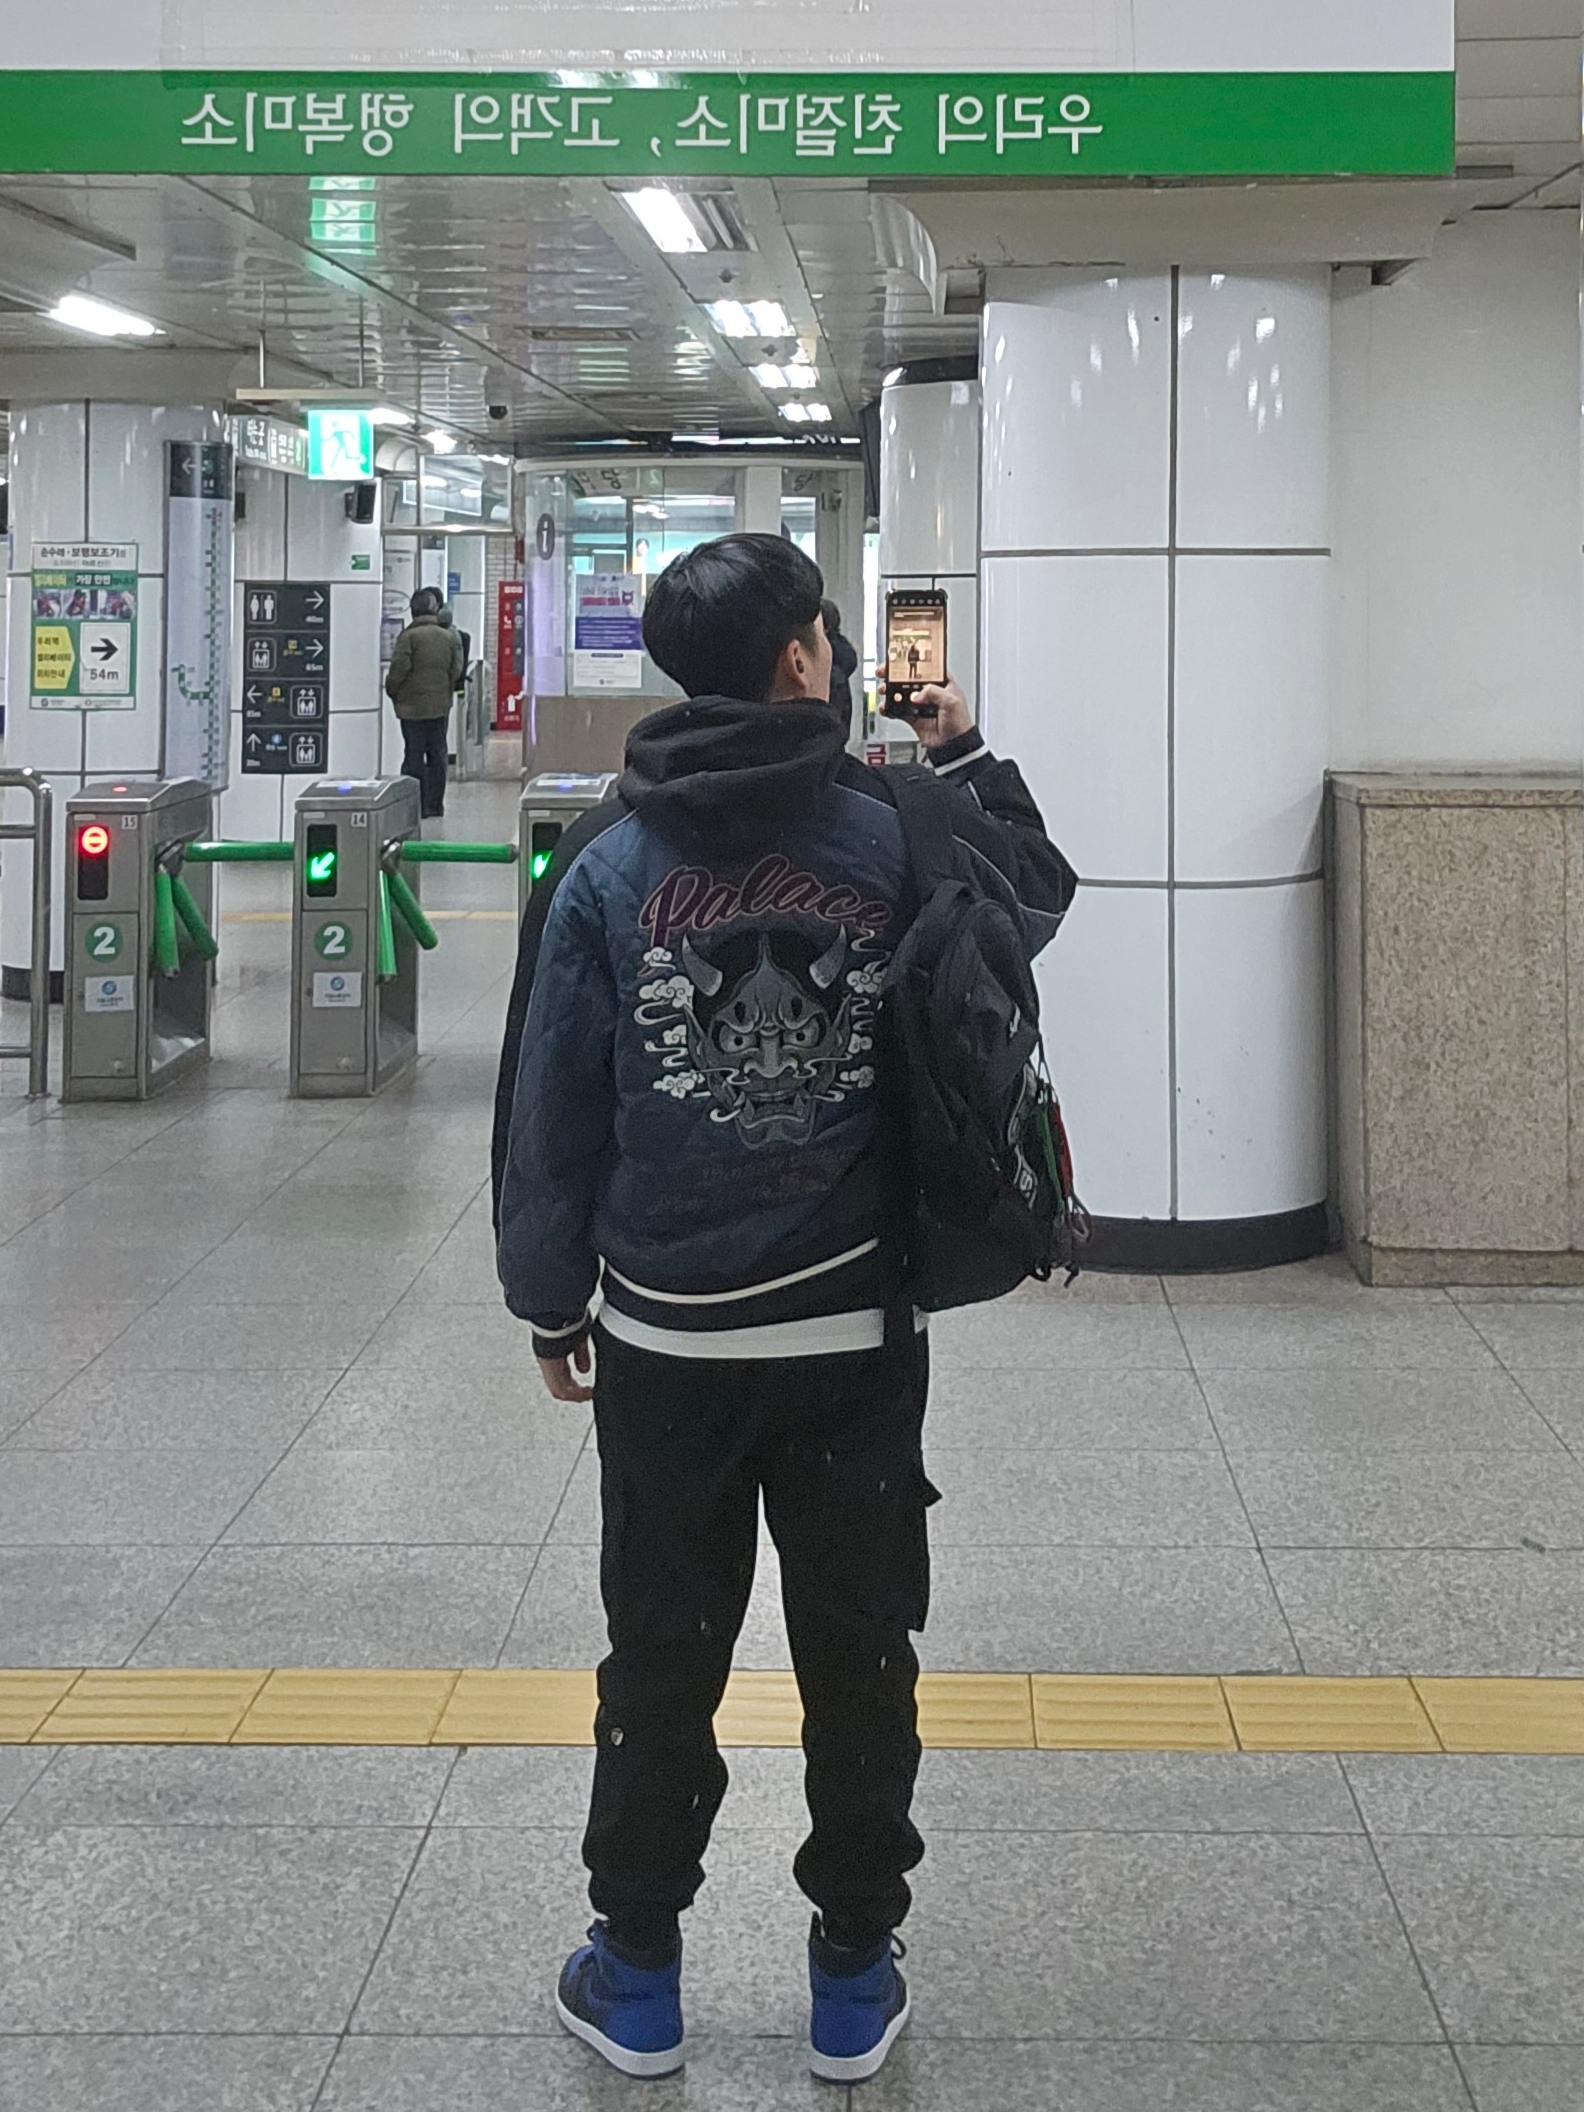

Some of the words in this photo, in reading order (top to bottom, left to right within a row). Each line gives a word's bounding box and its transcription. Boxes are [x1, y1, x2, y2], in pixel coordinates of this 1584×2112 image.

[90, 668, 119, 680] 54m
[124, 816, 136, 828] 15
[353, 814, 366, 825] 14
[638, 853, 894, 948] Palace
[93, 926, 116, 955] 2
[323, 925, 346, 954] 2
